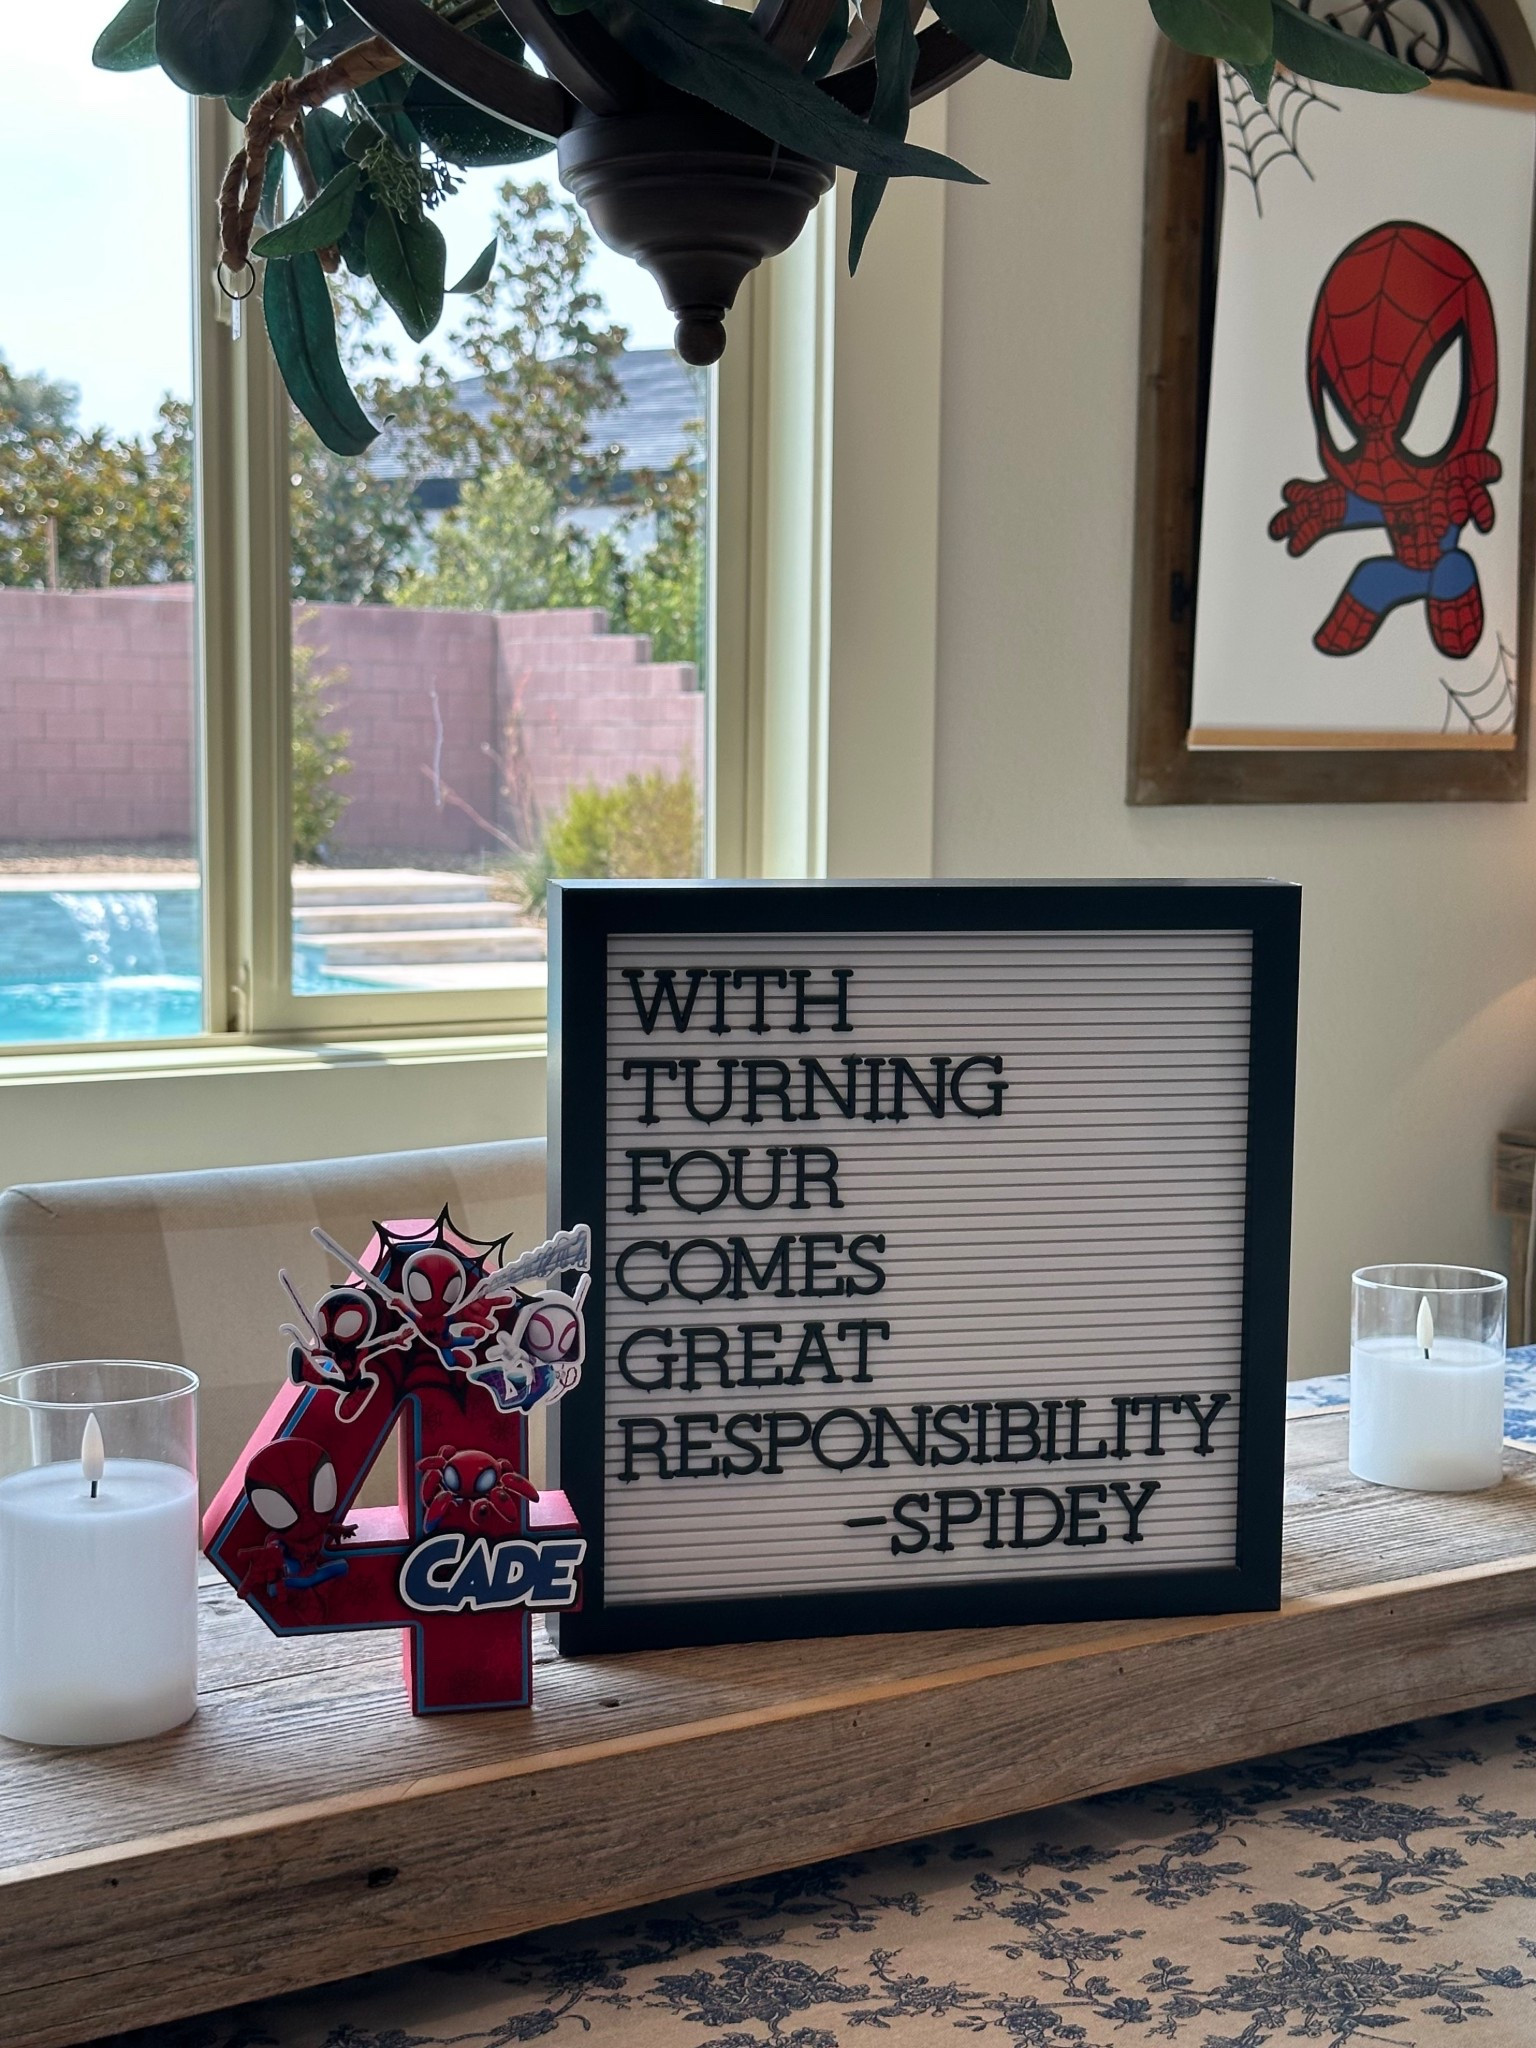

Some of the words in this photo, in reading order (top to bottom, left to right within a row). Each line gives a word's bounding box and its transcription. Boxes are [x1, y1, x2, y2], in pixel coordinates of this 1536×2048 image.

[621, 968, 853, 1035] WITH
[622, 1054, 1009, 1126] TURNING
[625, 1147, 844, 1215] FOUR
[615, 1234, 886, 1304] COMES
[618, 1319, 890, 1393] GREAT
[617, 1393, 1231, 1483] RESPONSIBILITY
[401, 1534, 587, 1611] CADE
